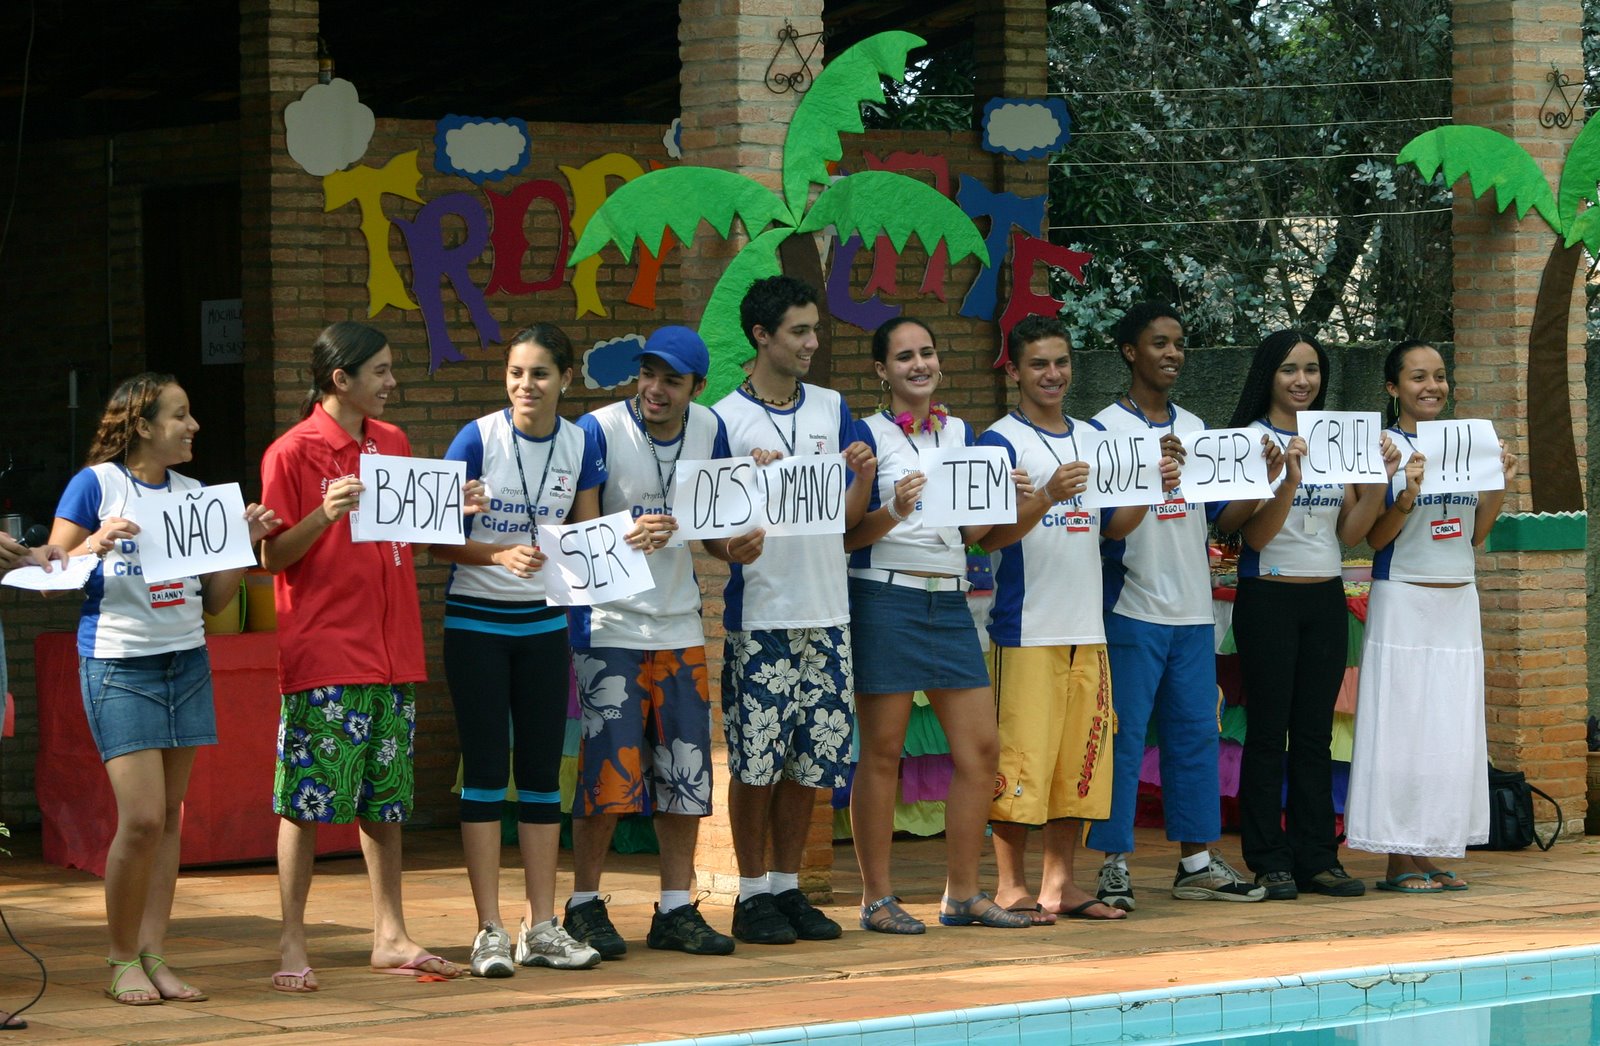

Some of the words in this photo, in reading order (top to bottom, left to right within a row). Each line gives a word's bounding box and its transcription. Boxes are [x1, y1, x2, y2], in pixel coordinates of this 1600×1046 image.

[1096, 437, 1149, 495] QUE
[1194, 433, 1255, 485] SER
[1308, 419, 1382, 474] CRUEL
[375, 468, 462, 534] BASTA
[942, 458, 1009, 510] TEM
[1417, 493, 1478, 507] idadania
[163, 491, 227, 559] NÃO
[1435, 525, 1456, 534] CAROL
[559, 522, 630, 590] SER
